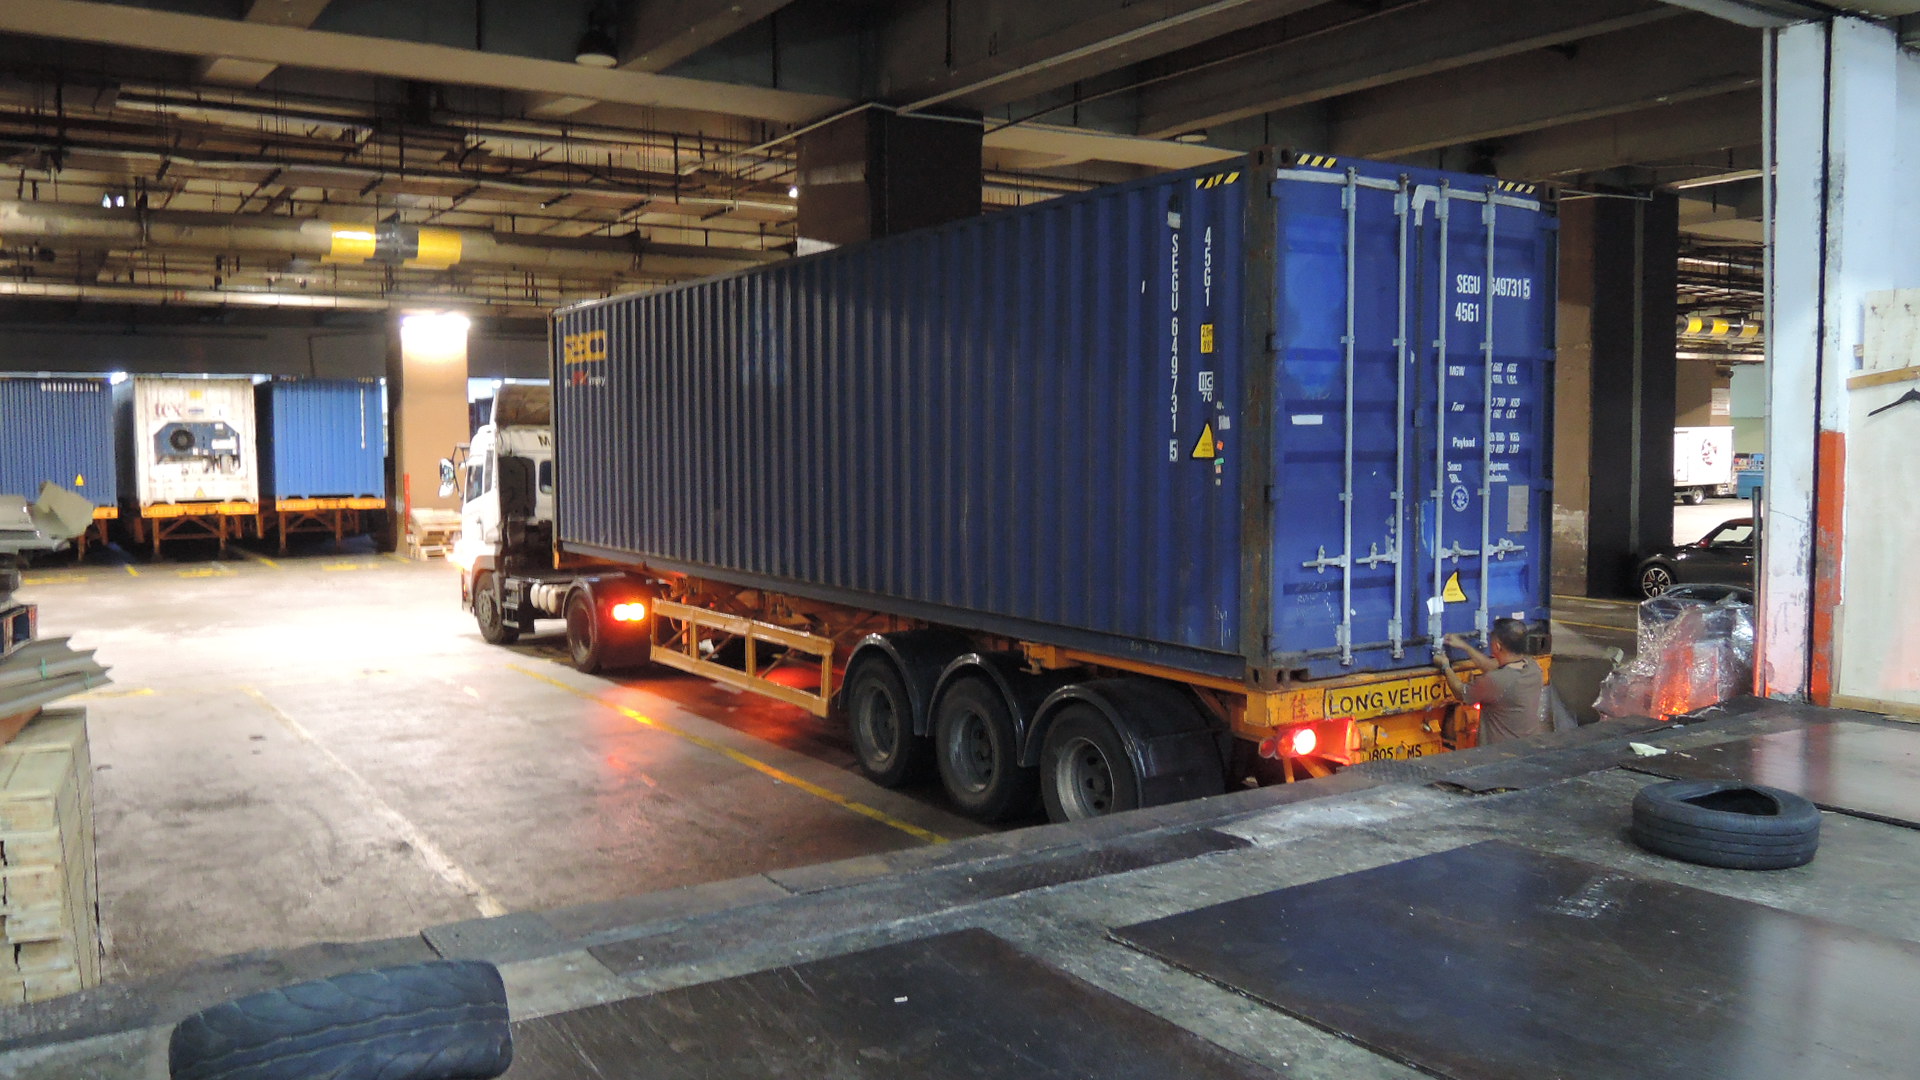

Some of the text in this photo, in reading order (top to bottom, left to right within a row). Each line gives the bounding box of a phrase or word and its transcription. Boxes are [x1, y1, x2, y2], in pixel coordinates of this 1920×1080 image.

[1171, 233, 1179, 312] SEGU
[1456, 274, 1480, 295] SEGU
[1455, 302, 1479, 322] 45G1
[1202, 391, 1212, 402] 70
[1453, 437, 1476, 450] Payload
[1328, 682, 1452, 715] LONG VEHICL
